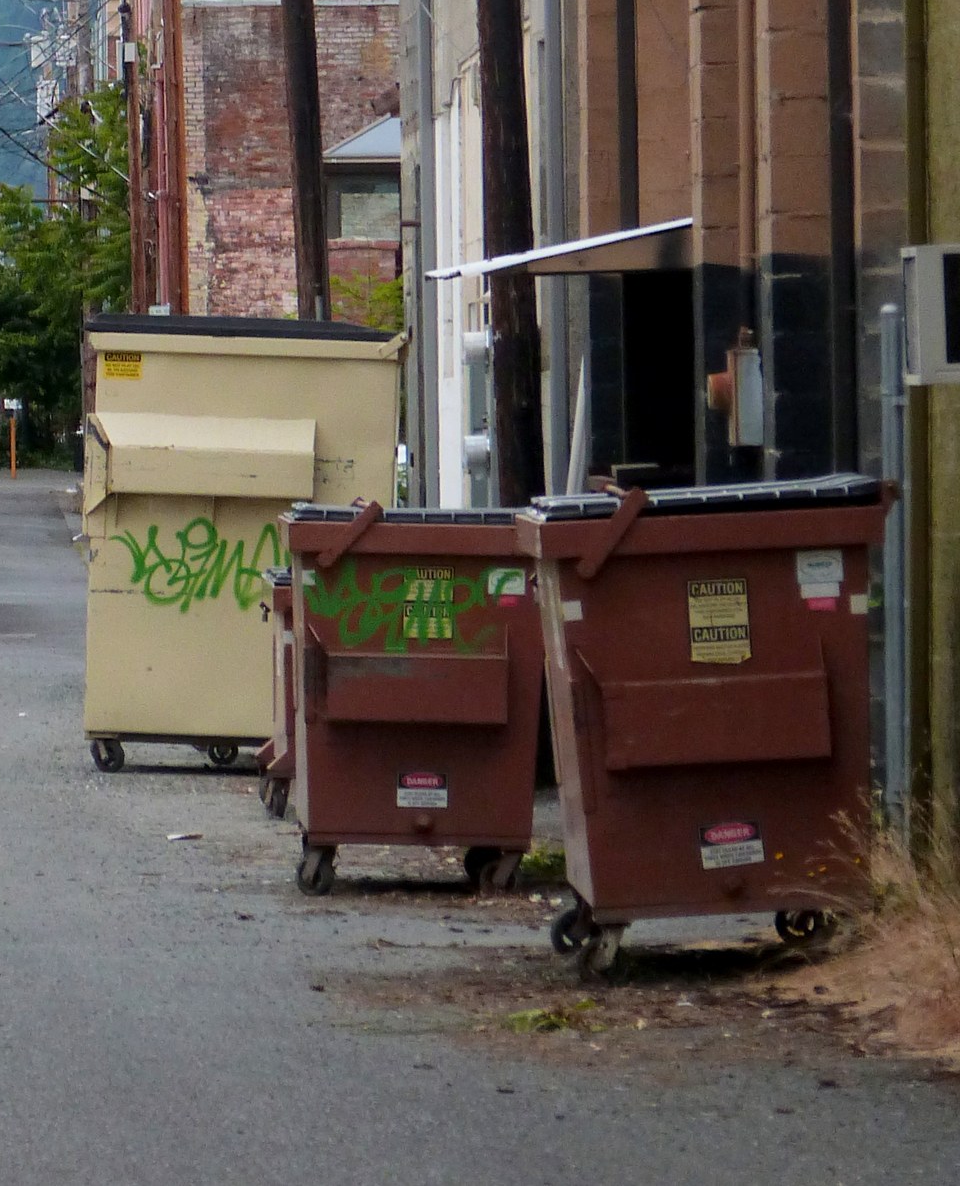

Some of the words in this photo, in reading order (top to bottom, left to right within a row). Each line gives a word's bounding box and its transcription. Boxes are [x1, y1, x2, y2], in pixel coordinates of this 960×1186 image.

[691, 581, 744, 595] CAUTION
[694, 626, 747, 642] CAUTION
[406, 777, 439, 786] DANGER
[710, 827, 750, 841] DANGER
